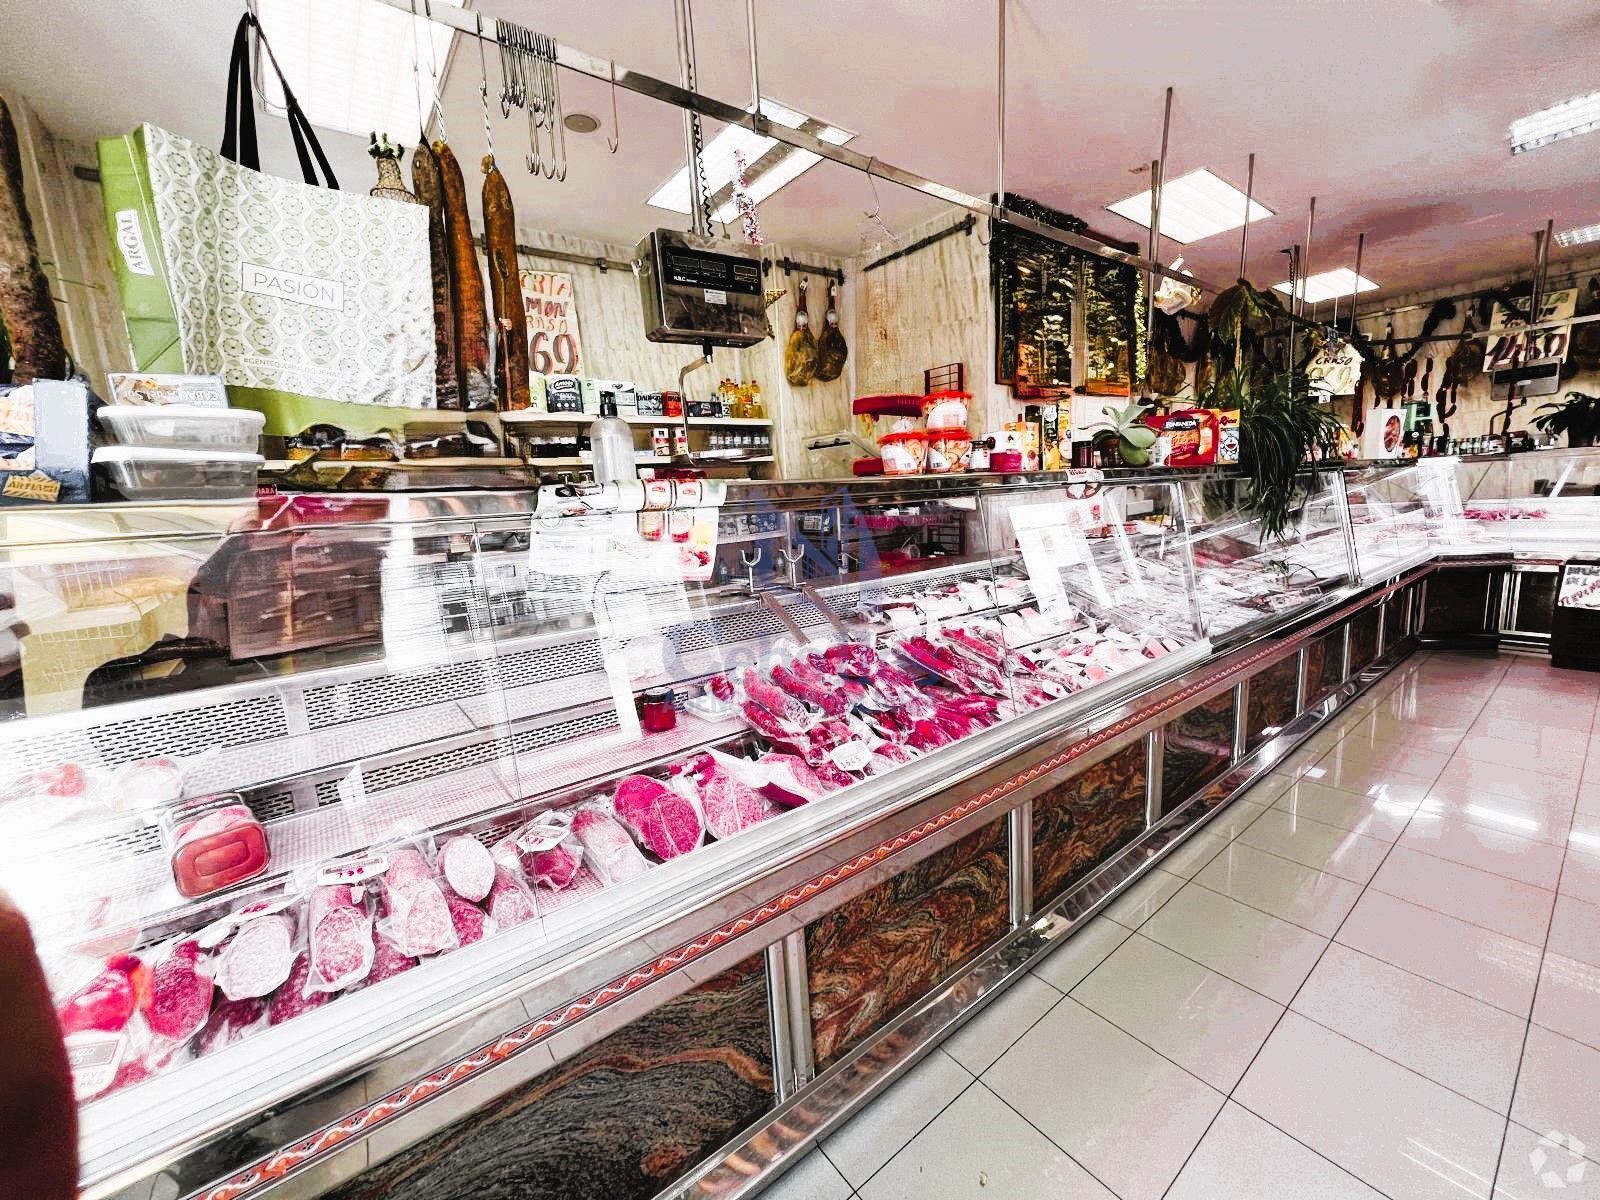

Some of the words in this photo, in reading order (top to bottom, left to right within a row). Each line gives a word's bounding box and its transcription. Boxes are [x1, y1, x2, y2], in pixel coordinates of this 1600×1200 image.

[120, 213, 147, 271] ARGAL
[253, 272, 335, 303] PASIÓN
[525, 296, 569, 318] MON
[123, 390, 143, 400] Sur
[167, 390, 219, 401] CABALLA
